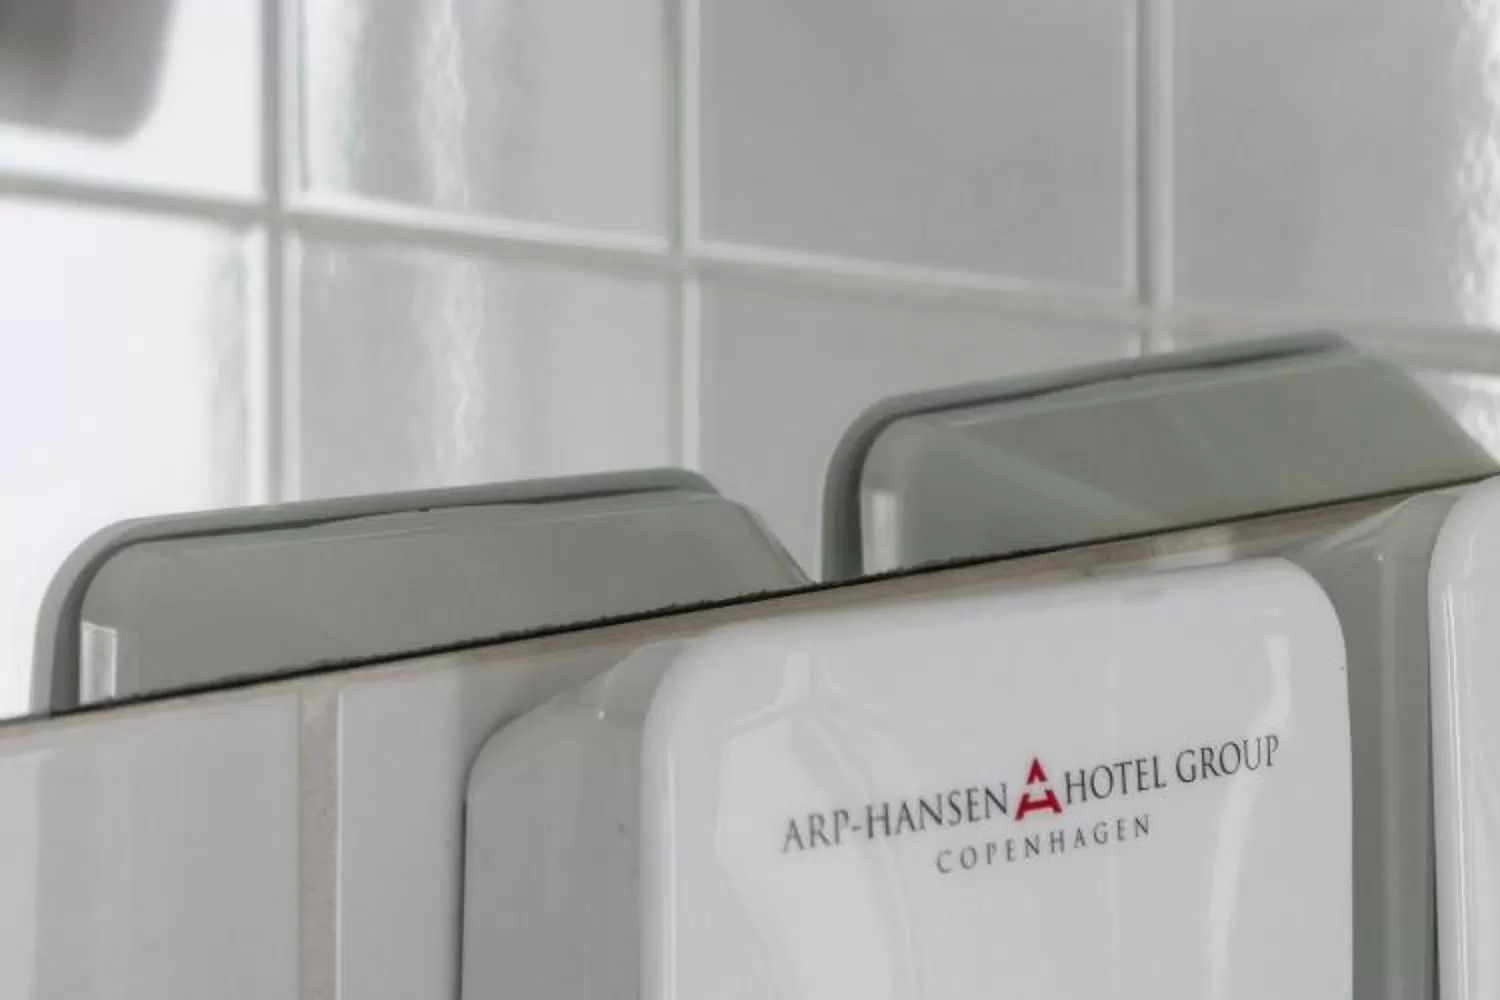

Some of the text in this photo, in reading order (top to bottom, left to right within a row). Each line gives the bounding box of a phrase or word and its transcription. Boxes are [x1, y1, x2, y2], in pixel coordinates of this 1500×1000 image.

[781, 782, 1009, 854] ARP-HANSEN
[1064, 755, 1167, 805] HOTEL
[1174, 734, 1280, 784] GROUP
[935, 814, 1150, 874] COPENHAGEN
